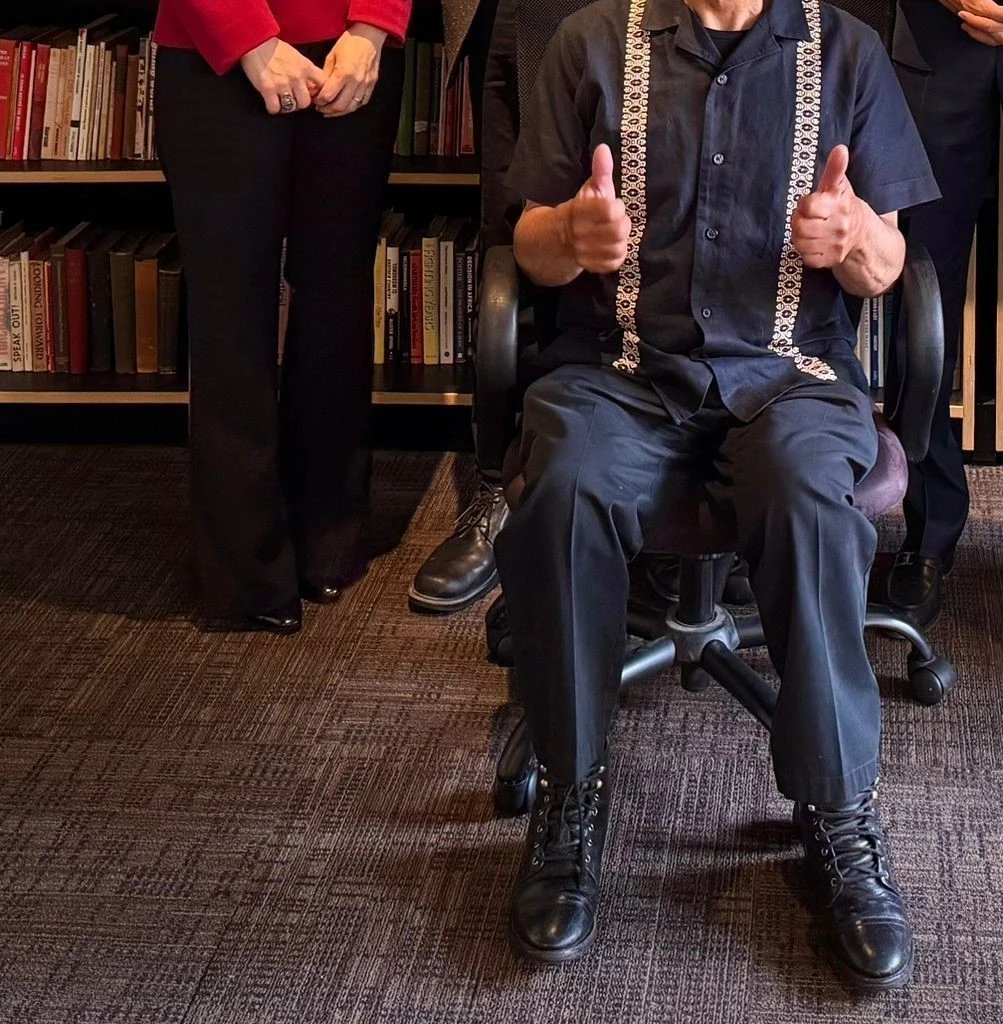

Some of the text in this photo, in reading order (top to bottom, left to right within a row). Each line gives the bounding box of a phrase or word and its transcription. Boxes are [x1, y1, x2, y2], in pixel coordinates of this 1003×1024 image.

[11, 304, 22, 362] SPEAK OUT!
[33, 263, 44, 360] LOOKING FORWARD
